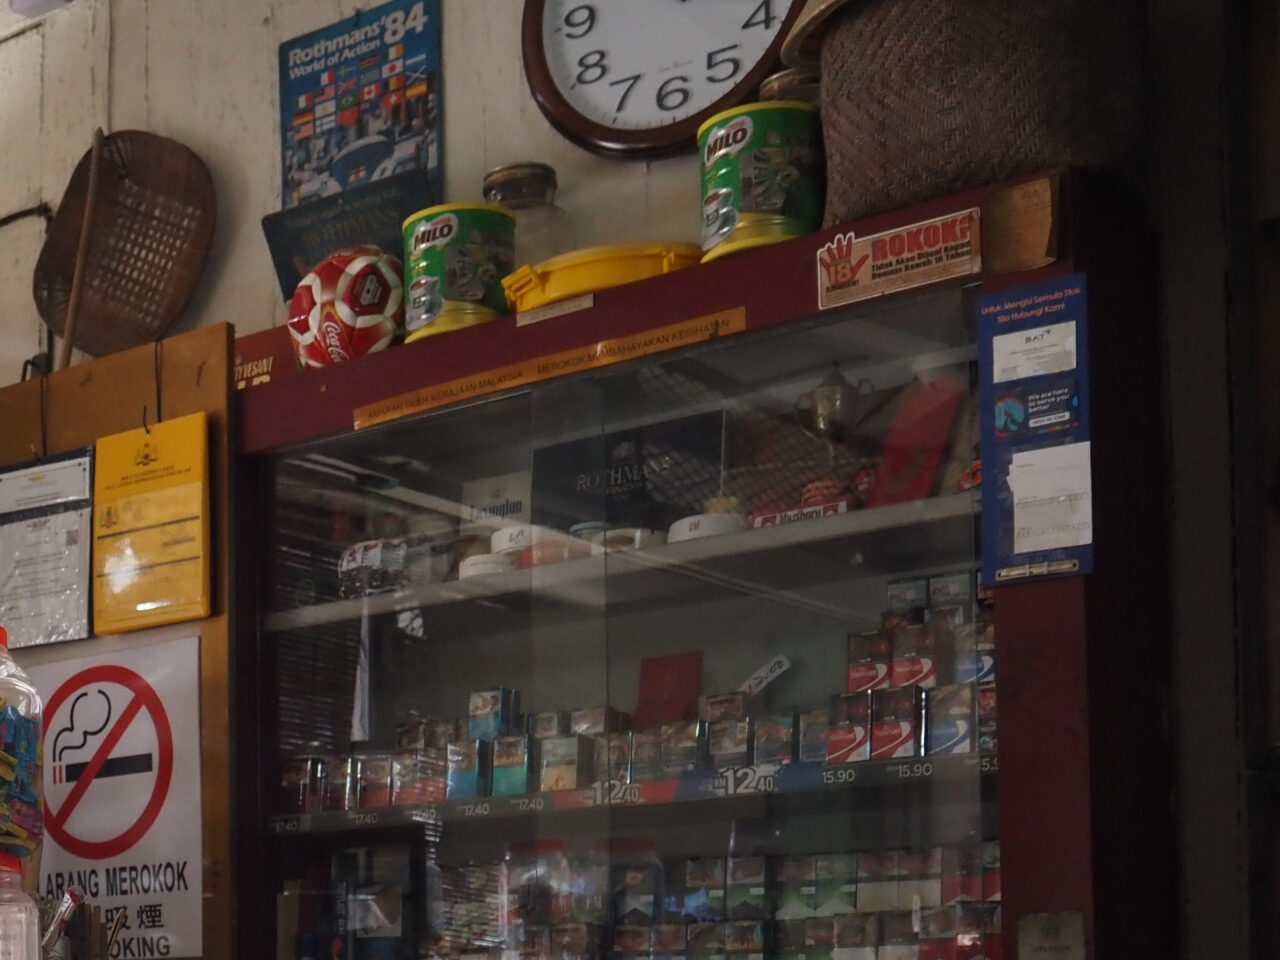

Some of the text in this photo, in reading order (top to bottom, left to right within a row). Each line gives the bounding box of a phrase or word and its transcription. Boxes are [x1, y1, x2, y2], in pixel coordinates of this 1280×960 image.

[564, 5, 595, 39] 9
[741, 0, 776, 30] 4
[289, 23, 381, 67] Rothmans
[290, 39, 380, 80] World of Action
[576, 50, 607, 84] 8
[706, 44, 740, 83] 5
[610, 74, 641, 112] 7
[656, 76, 690, 111] 6
[706, 127, 748, 162] MILO
[413, 223, 453, 251] MILO
[829, 260, 852, 286] 18
[1044, 302, 1065, 313] Kami
[536, 355, 585, 375] MEROKOK
[670, 318, 731, 344] KESIHATAN
[822, 762, 933, 784] 15.90 15.90
[464, 803, 490, 817] 17.40
[518, 798, 545, 811] 17.40
[41, 861, 189, 902] ARANG MEROKOK
